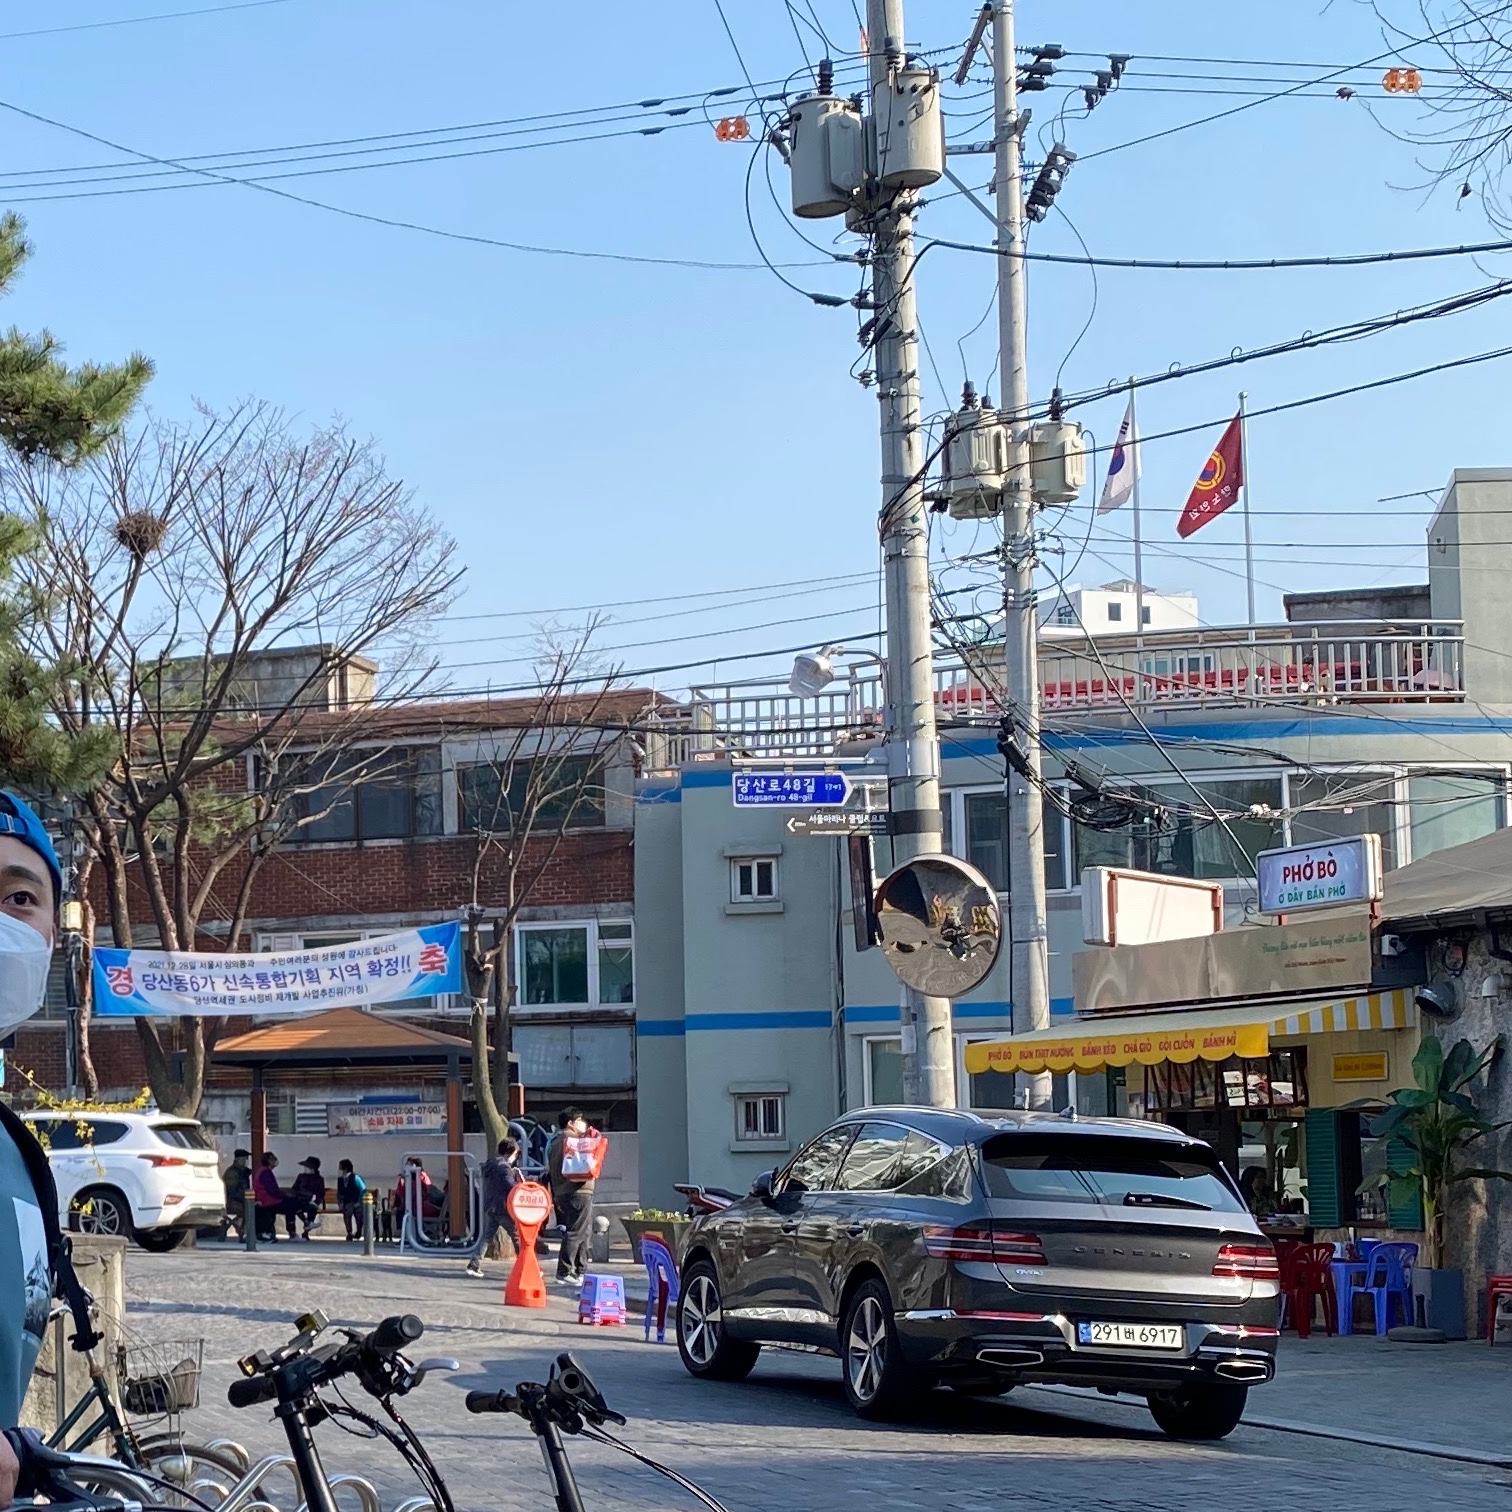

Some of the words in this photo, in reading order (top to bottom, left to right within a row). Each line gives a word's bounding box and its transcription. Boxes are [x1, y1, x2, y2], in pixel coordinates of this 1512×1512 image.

[737, 777, 816, 793] 당산로48길
[738, 793, 786, 803] Dangsan-ro
[788, 793, 813, 803] 48-gil
[1282, 854, 1314, 884] PHỞ
[199, 960, 222, 970] 서울시
[270, 954, 319, 967] 주민여러분의
[348, 944, 398, 960] 감사드립니다
[418, 943, 448, 974] 축
[108, 966, 134, 997] 경
[142, 973, 215, 992] 당산동6가
[223, 966, 321, 992] 신속통합기획
[328, 962, 361, 983] 지역
[239, 993, 273, 1004] 도시정비
[275, 990, 299, 1001] 재개발
